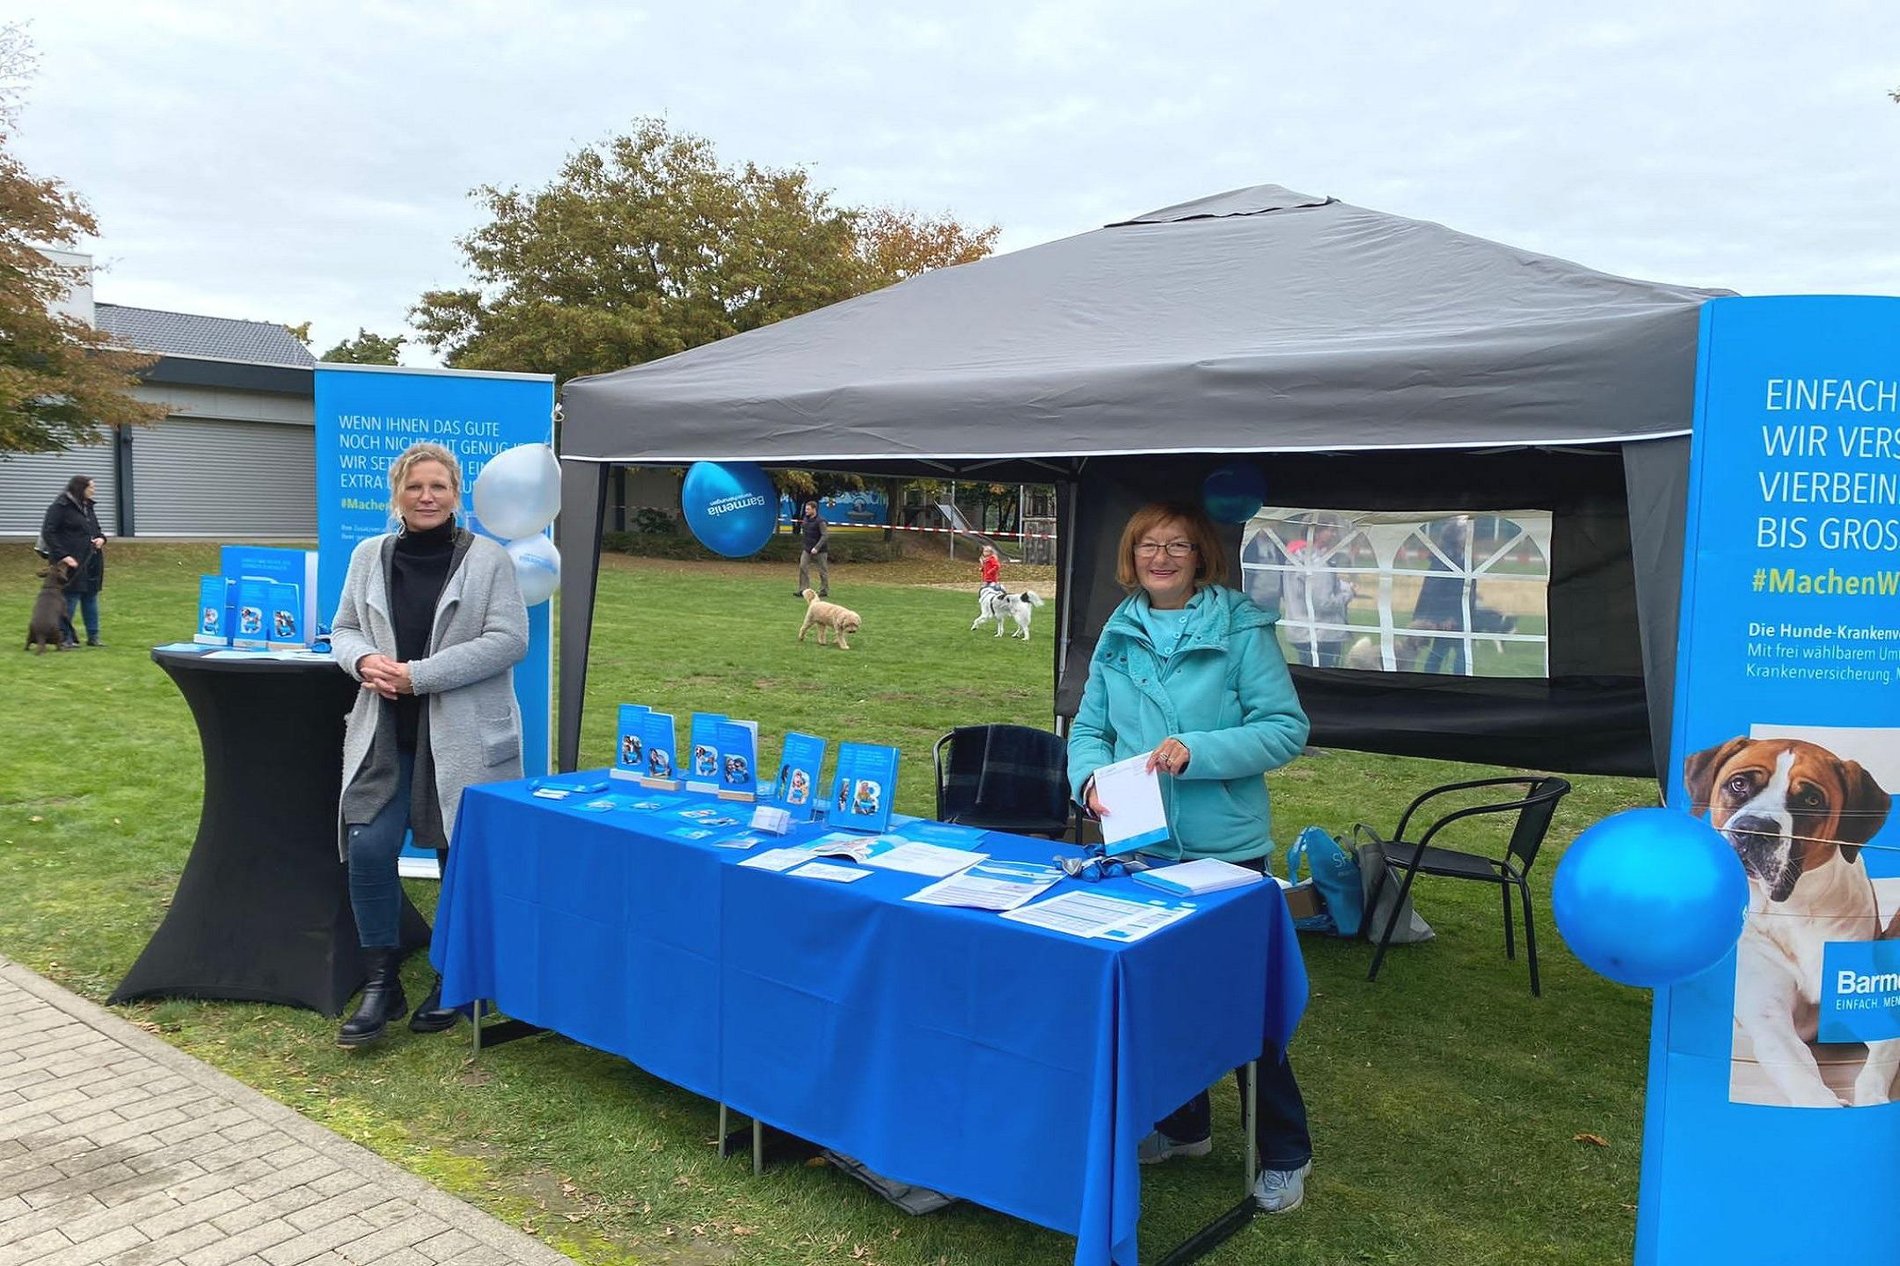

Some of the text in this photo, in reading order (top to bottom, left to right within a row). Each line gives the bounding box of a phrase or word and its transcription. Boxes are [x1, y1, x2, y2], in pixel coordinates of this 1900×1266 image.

[1765, 378, 1897, 413] EINFACH
[338, 415, 500, 437] WENN IHNEN DAS GUTE
[339, 433, 381, 450] NOCH
[1762, 424, 1829, 458] WIR
[339, 454, 367, 470] WIR
[340, 473, 384, 490] EXTRA
[1758, 471, 1900, 505] VIERBEIN
[341, 498, 391, 511] #Mache
[707, 495, 766, 517] Barmenia
[1756, 516, 1900, 551] BIS GROS
[1749, 622, 1900, 640] Die Hunde-Krankenv
[1747, 642, 1771, 658] Mit
[1776, 643, 1799, 658] frei
[1802, 644, 1876, 660] wählbarem
[1837, 970, 1900, 994] Barm
